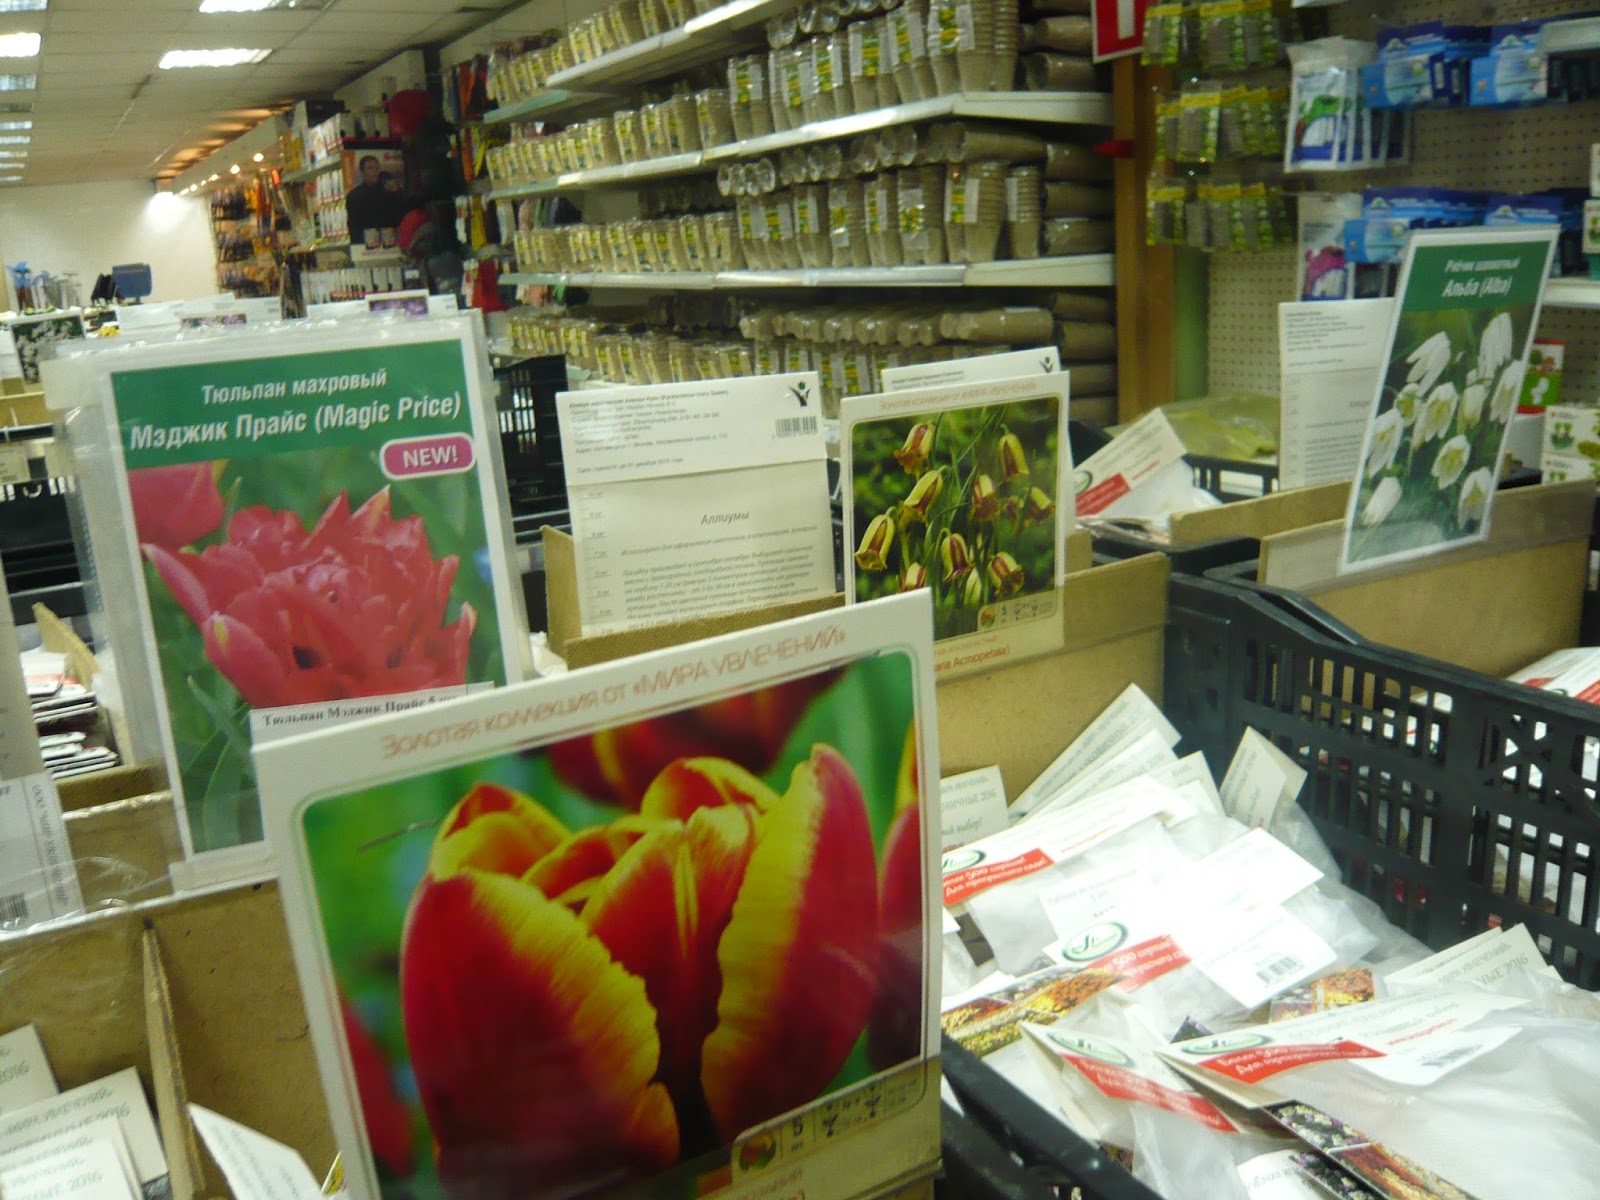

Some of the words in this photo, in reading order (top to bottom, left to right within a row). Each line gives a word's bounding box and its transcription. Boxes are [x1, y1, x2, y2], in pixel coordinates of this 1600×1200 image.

[202, 381, 286, 405] Тюльпан
[292, 368, 387, 398] махровый
[130, 420, 228, 450] Мэджик
[237, 409, 307, 441] Прайс
[316, 401, 390, 433] (Magic
[399, 391, 462, 420] Price)
[403, 447, 459, 468] NEW!
[701, 511, 750, 526] Аллиумы
[633, 660, 711, 694] «МИРА
[711, 624, 848, 676] УВЛЕЧЕНИЙ»
[263, 711, 324, 727] Тюльпан
